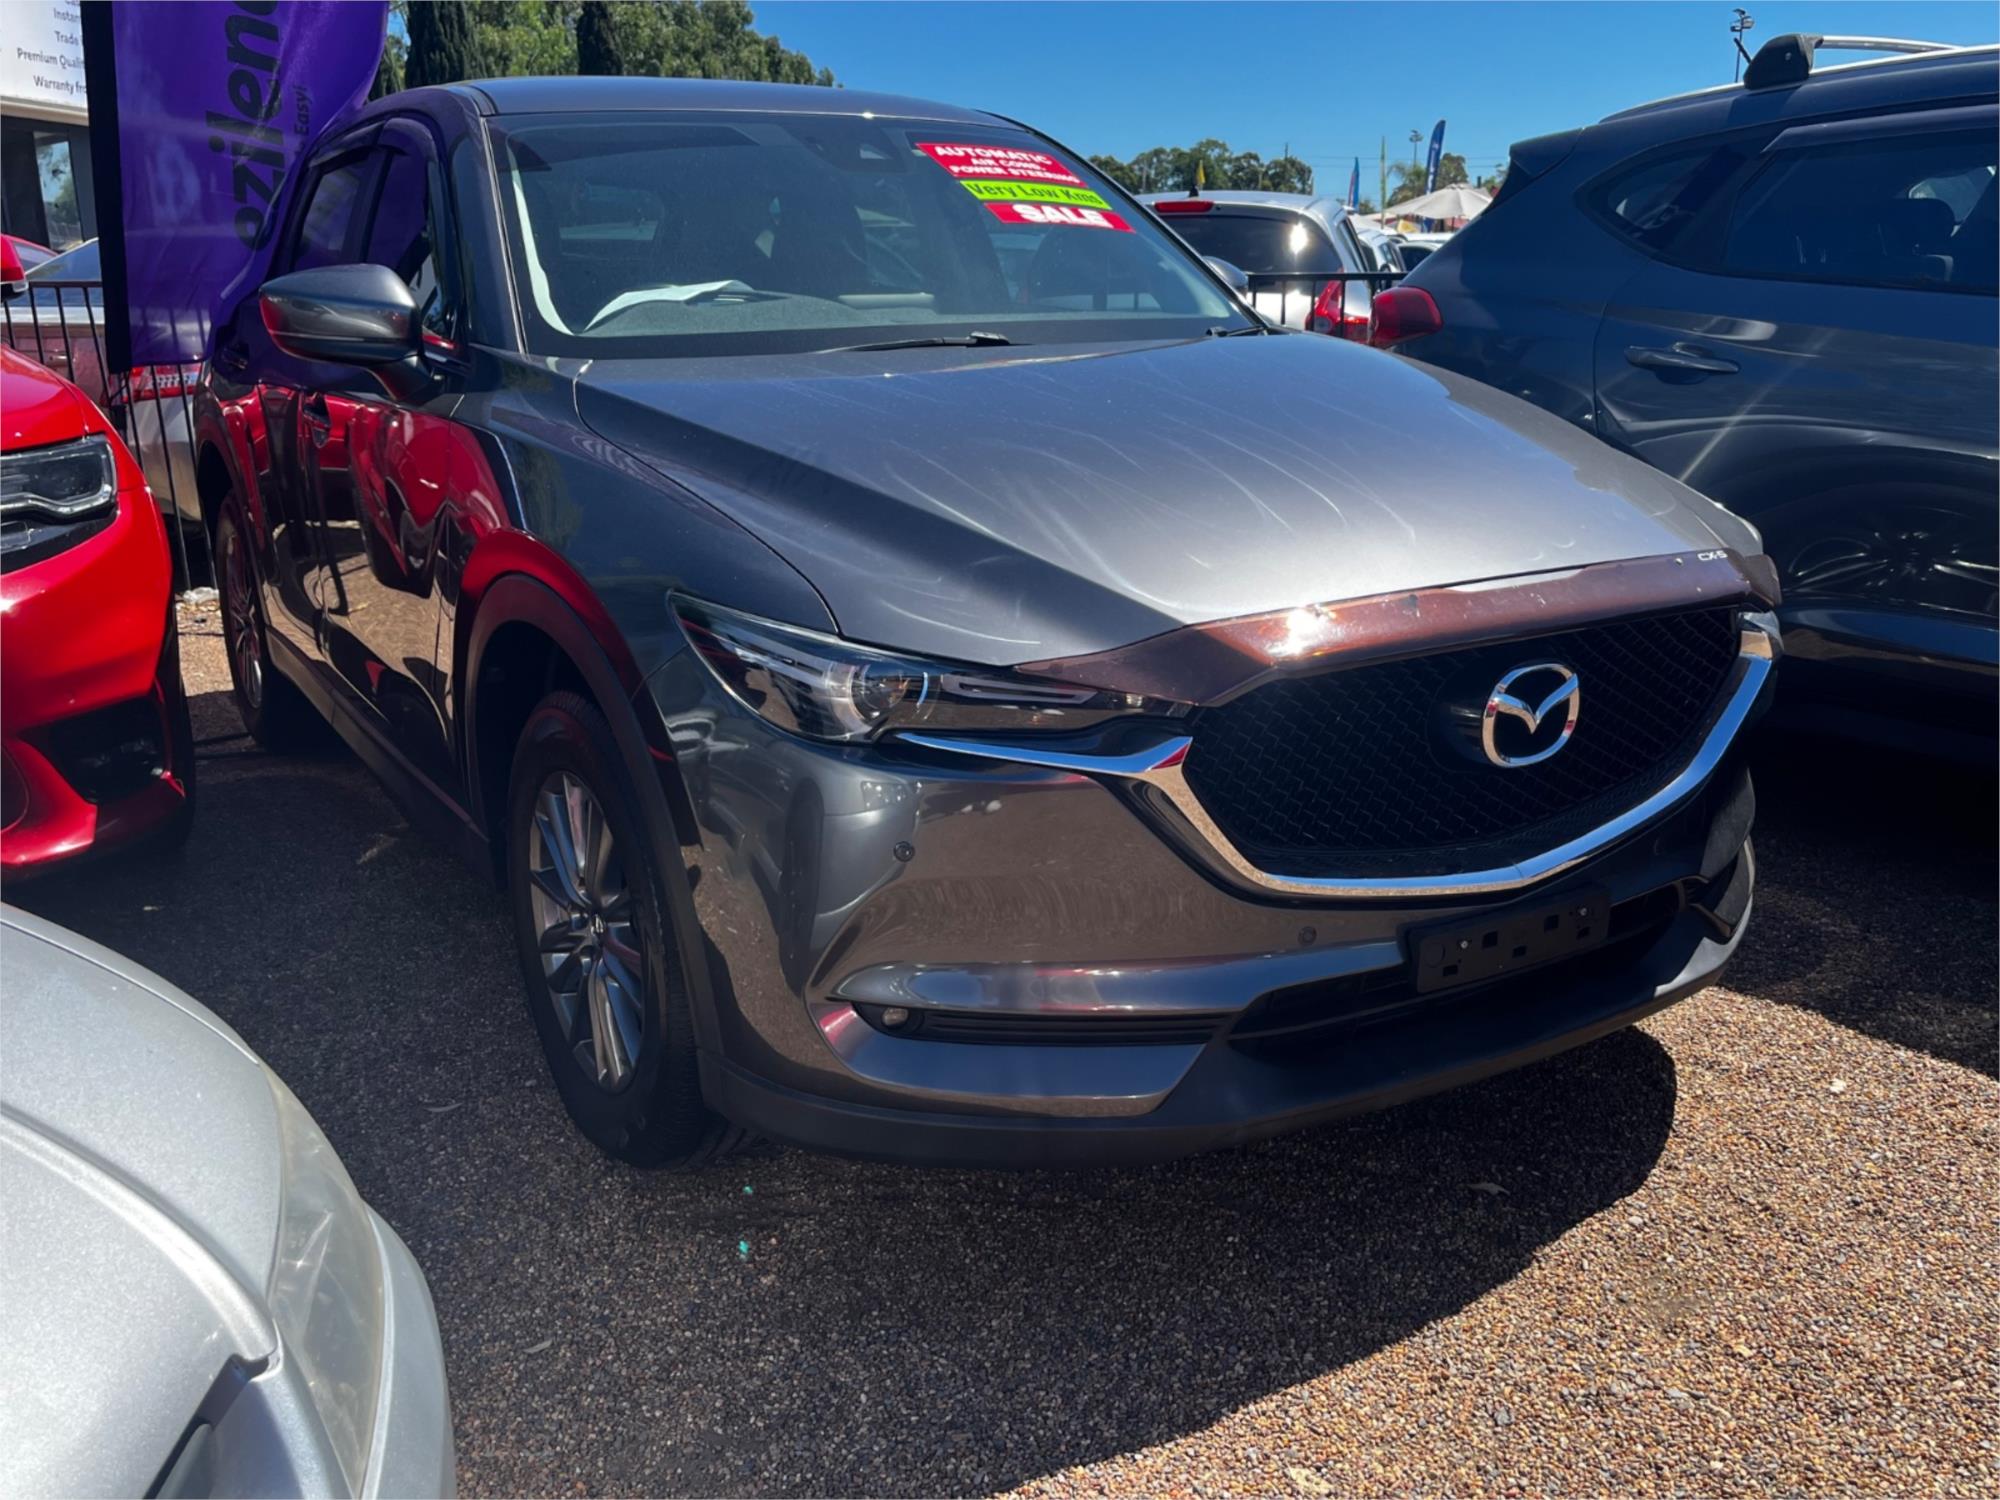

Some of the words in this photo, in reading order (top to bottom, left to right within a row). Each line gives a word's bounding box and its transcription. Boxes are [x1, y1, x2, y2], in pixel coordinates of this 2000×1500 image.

[17, 47, 58, 66] Premium
[33, 75, 74, 95] Warranty
[293, 84, 313, 136] Easy!
[205, 0, 285, 250] ozilen
[934, 146, 1053, 165] AUTOMATIC
[970, 158, 999, 167] AIR
[998, 159, 1046, 171] COND.
[948, 165, 1009, 175] POWER
[1007, 168, 1080, 183] STEERING
[965, 182, 1018, 198] Very
[1017, 184, 1060, 199] Low
[1059, 188, 1103, 205] Kms
[1012, 204, 1115, 229] SALE
